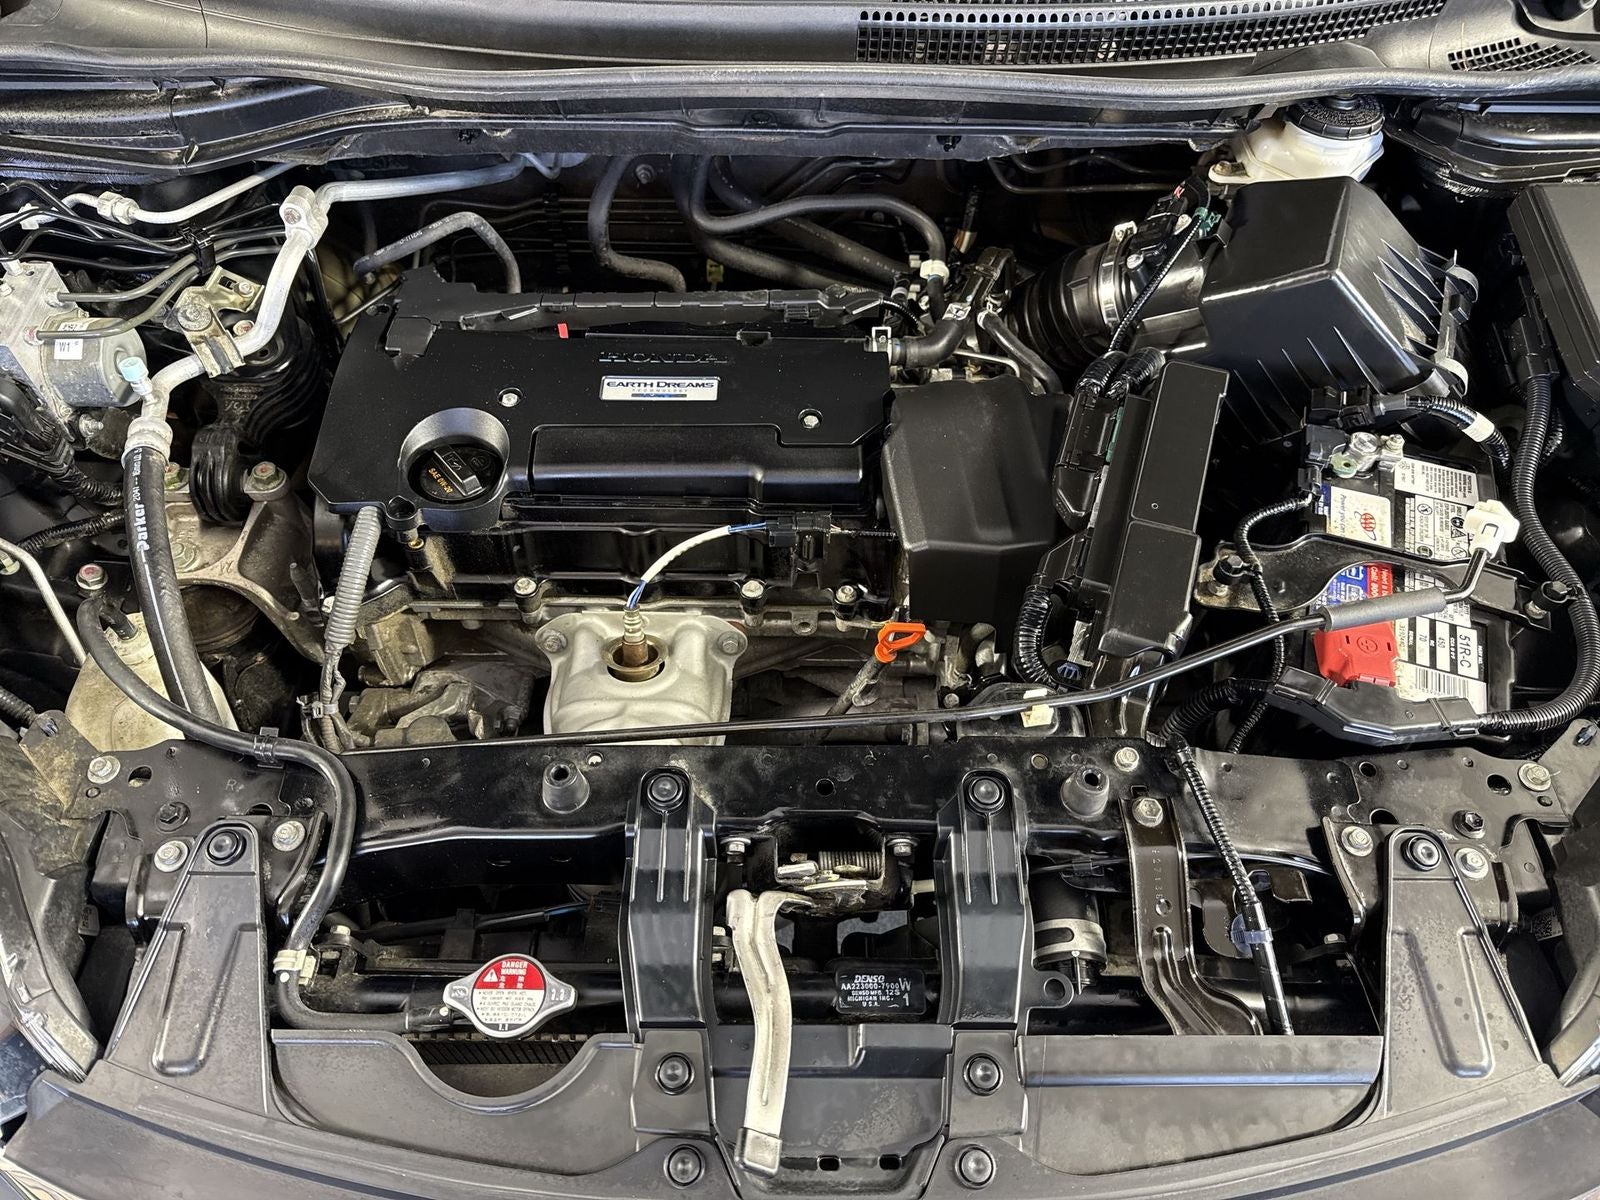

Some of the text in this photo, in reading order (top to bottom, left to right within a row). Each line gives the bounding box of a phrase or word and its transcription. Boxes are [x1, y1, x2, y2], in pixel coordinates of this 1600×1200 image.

[599, 352, 728, 363] HONDA
[133, 503, 150, 551] Parker
[1419, 634, 1427, 642] 70
[1459, 634, 1472, 668] 51R-C
[502, 961, 528, 969] DANGER
[854, 975, 885, 983] DENSO
